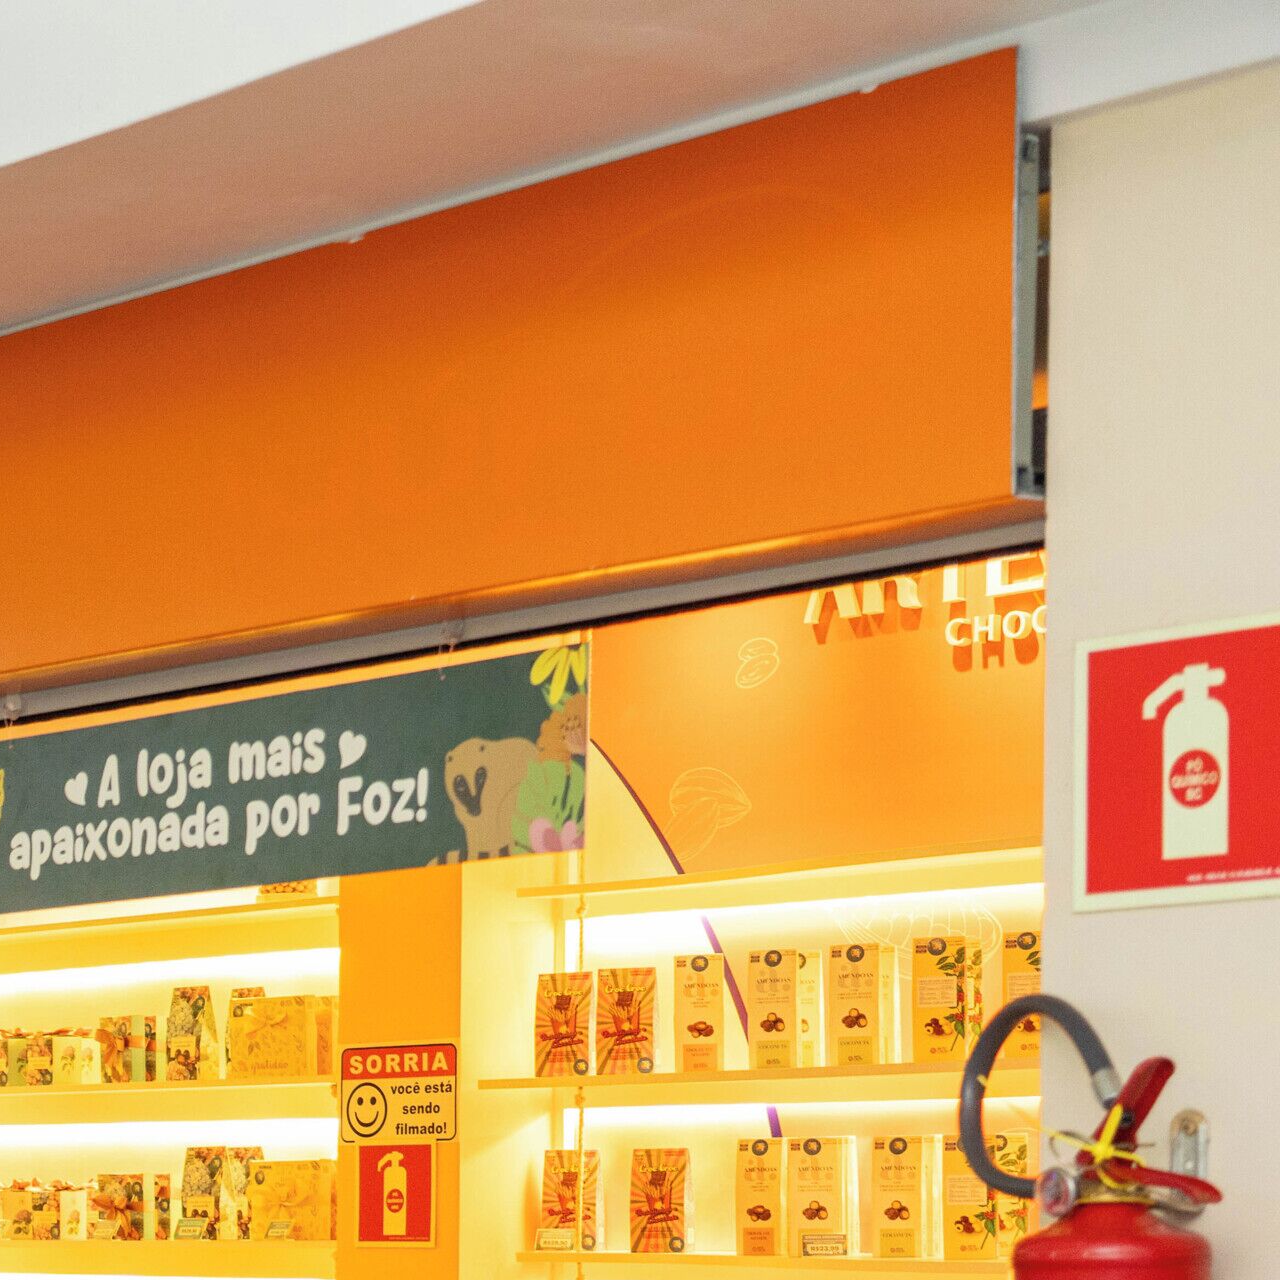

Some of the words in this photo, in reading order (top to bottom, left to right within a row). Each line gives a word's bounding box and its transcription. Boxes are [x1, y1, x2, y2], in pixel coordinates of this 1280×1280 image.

[97, 756, 120, 808] A
[137, 748, 212, 809] loja
[227, 728, 326, 782] mais
[10, 806, 230, 880] apaixonada
[246, 790, 320, 855] por
[337, 767, 430, 836] Foz!
[349, 1051, 449, 1075] SORRIA
[391, 1082, 420, 1095] você
[425, 1080, 453, 1094] está
[402, 1102, 441, 1115] sendo
[395, 1122, 447, 1135] filmado!
